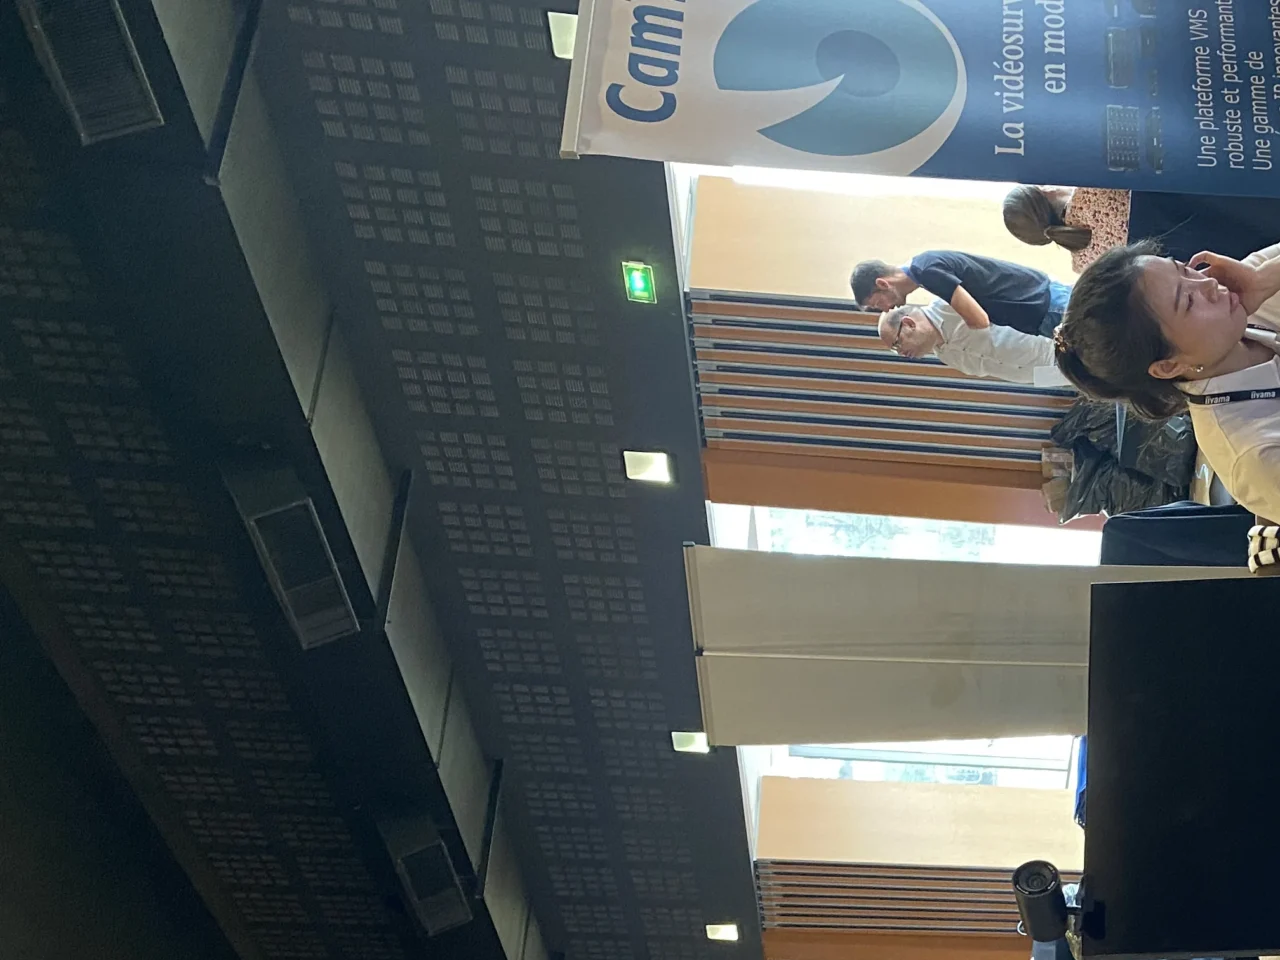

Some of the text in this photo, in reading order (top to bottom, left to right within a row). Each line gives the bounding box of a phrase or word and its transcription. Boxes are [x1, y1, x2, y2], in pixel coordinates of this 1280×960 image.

[605, 0, 685, 123] Cam
[1043, 62, 1067, 94] en
[1188, 8, 1220, 168] Une plateforme VMS
[1215, 0, 1245, 169] robuste et performant
[1244, 50, 1274, 171] Une gamme de
[994, 122, 1025, 156] La
